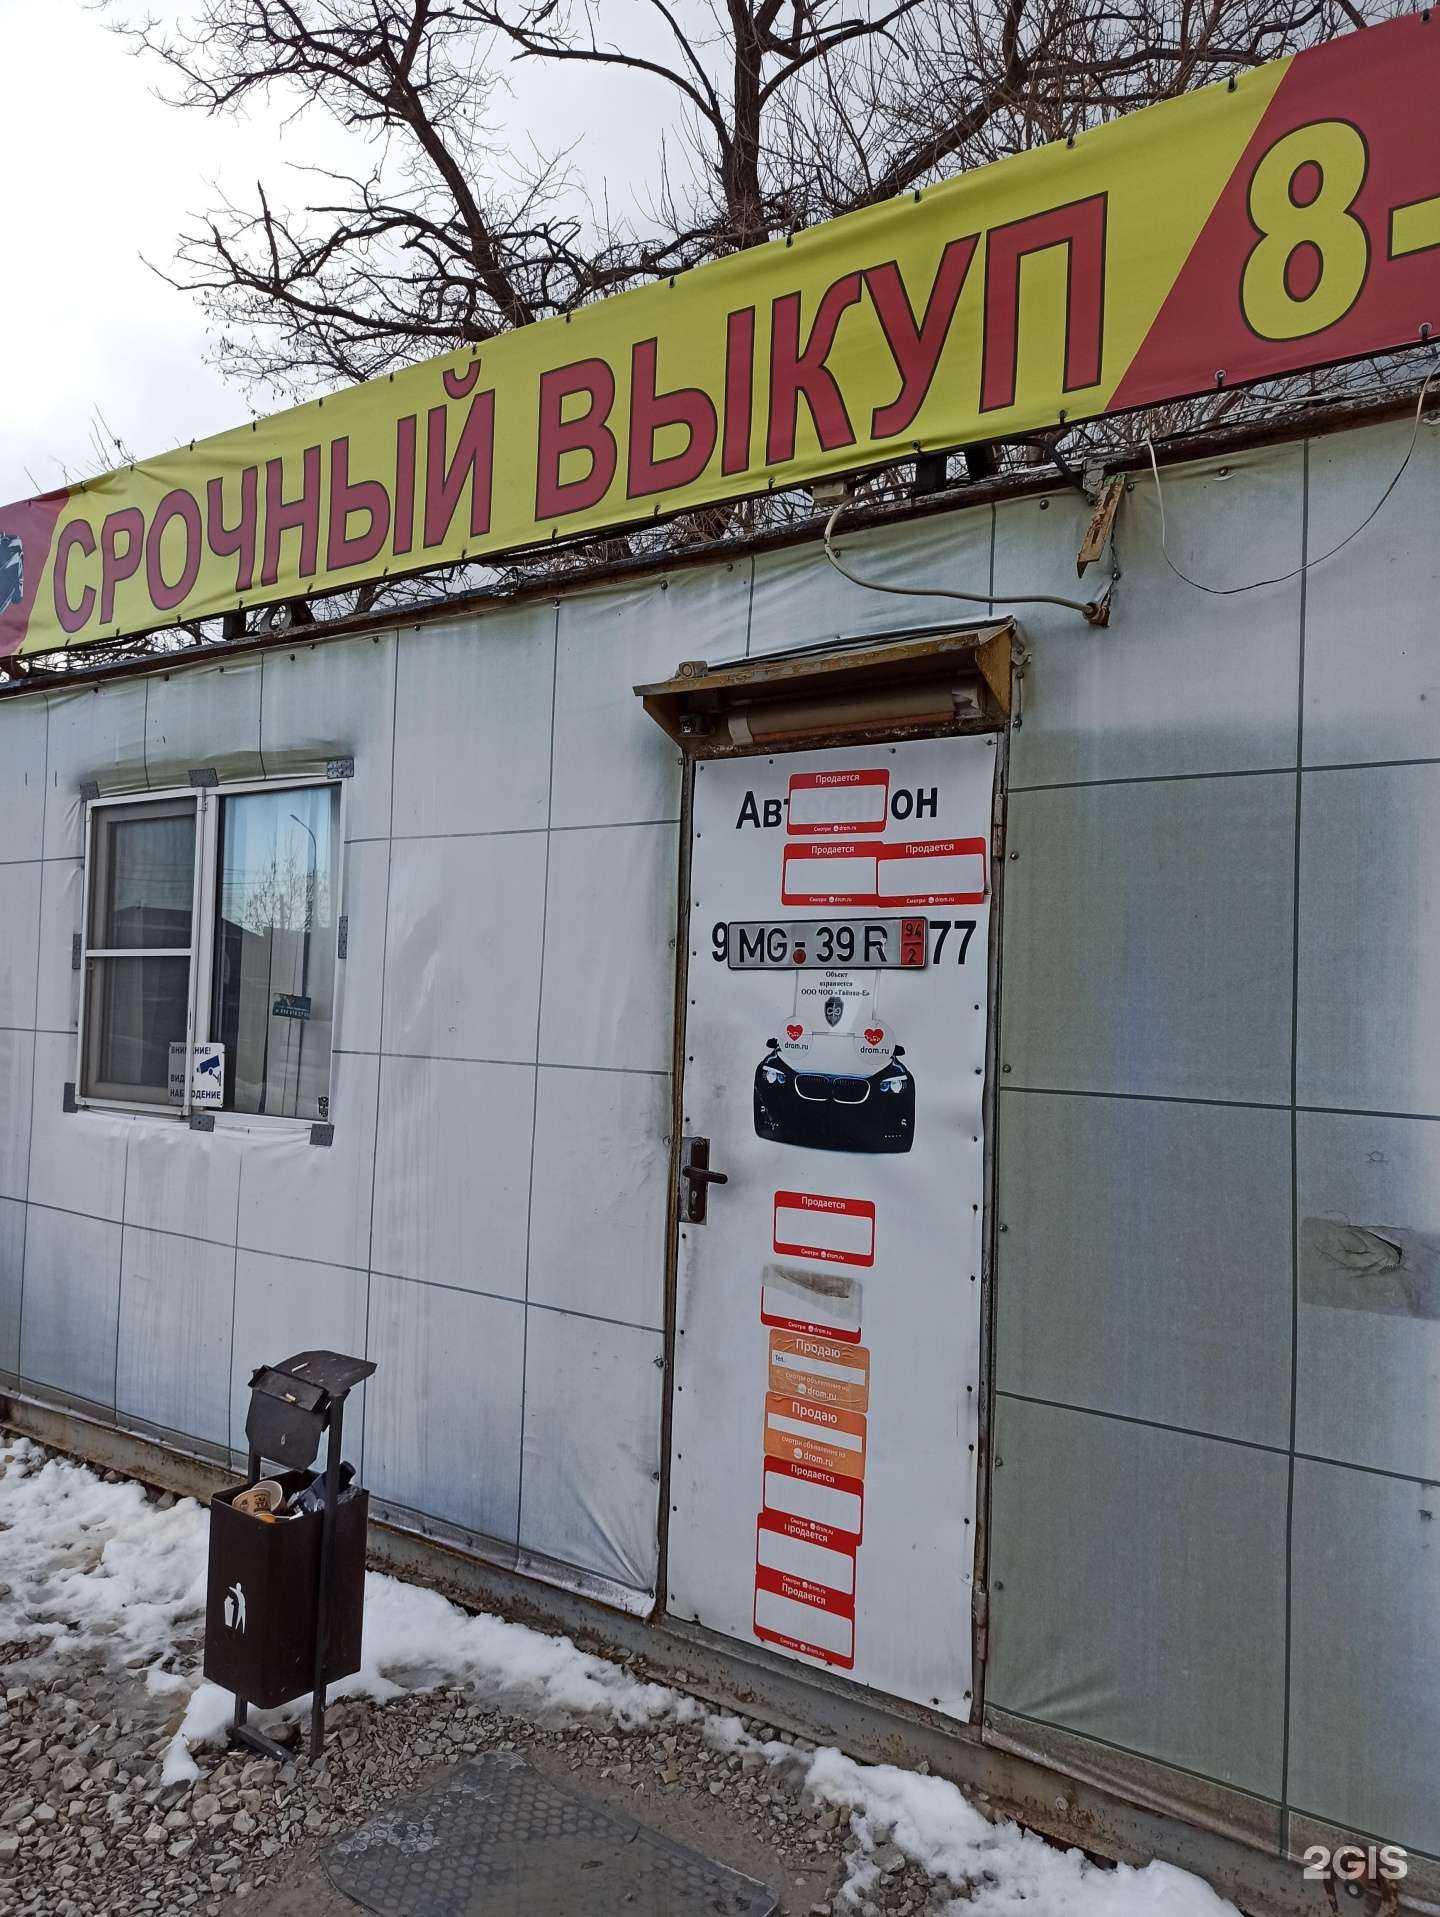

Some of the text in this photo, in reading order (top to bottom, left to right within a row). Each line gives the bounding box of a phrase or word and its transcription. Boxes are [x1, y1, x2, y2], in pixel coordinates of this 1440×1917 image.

[53, 359, 495, 633] СРОЧНЫЙ
[535, 191, 1108, 521] ВЫКУП
[815, 774, 860, 785] Продается
[811, 845, 855, 855] Продается
[906, 843, 954, 854] Продается
[170, 1046, 211, 1055] ВНИНИЕ!
[784, 1041, 809, 1051] drom.ru
[860, 1046, 889, 1055] drom.ru
[170, 1074, 194, 1083] ВИД
[170, 1089, 221, 1100] НАБДЕНИЕ
[801, 1196, 846, 1210] Продается
[795, 1338, 841, 1359] Продаю
[807, 1386, 837, 1400] drom.ru
[791, 1401, 838, 1424] Продаю
[803, 1451, 833, 1467] drom.ru
[791, 1463, 835, 1483] Продается
[782, 1582, 826, 1605] Продается
